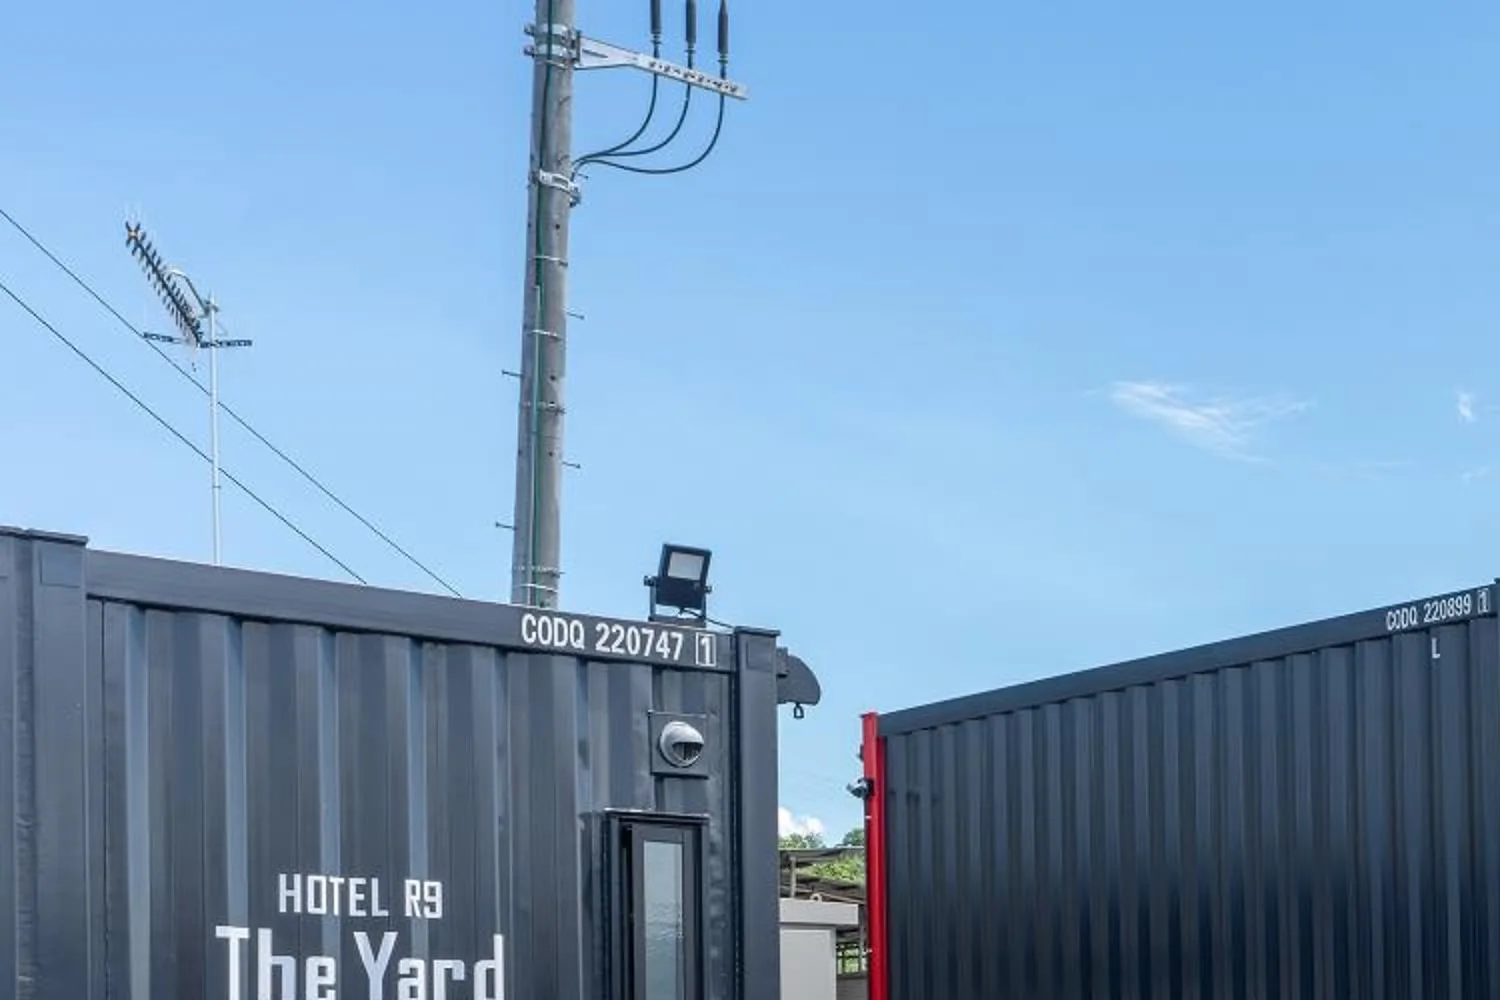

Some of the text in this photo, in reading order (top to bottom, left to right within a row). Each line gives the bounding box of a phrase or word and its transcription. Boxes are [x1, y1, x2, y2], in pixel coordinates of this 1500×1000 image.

[1423, 594, 1471, 623] 220899
[521, 613, 715, 665] CODQ 220747 1
[278, 873, 443, 919] HOTEL R9
